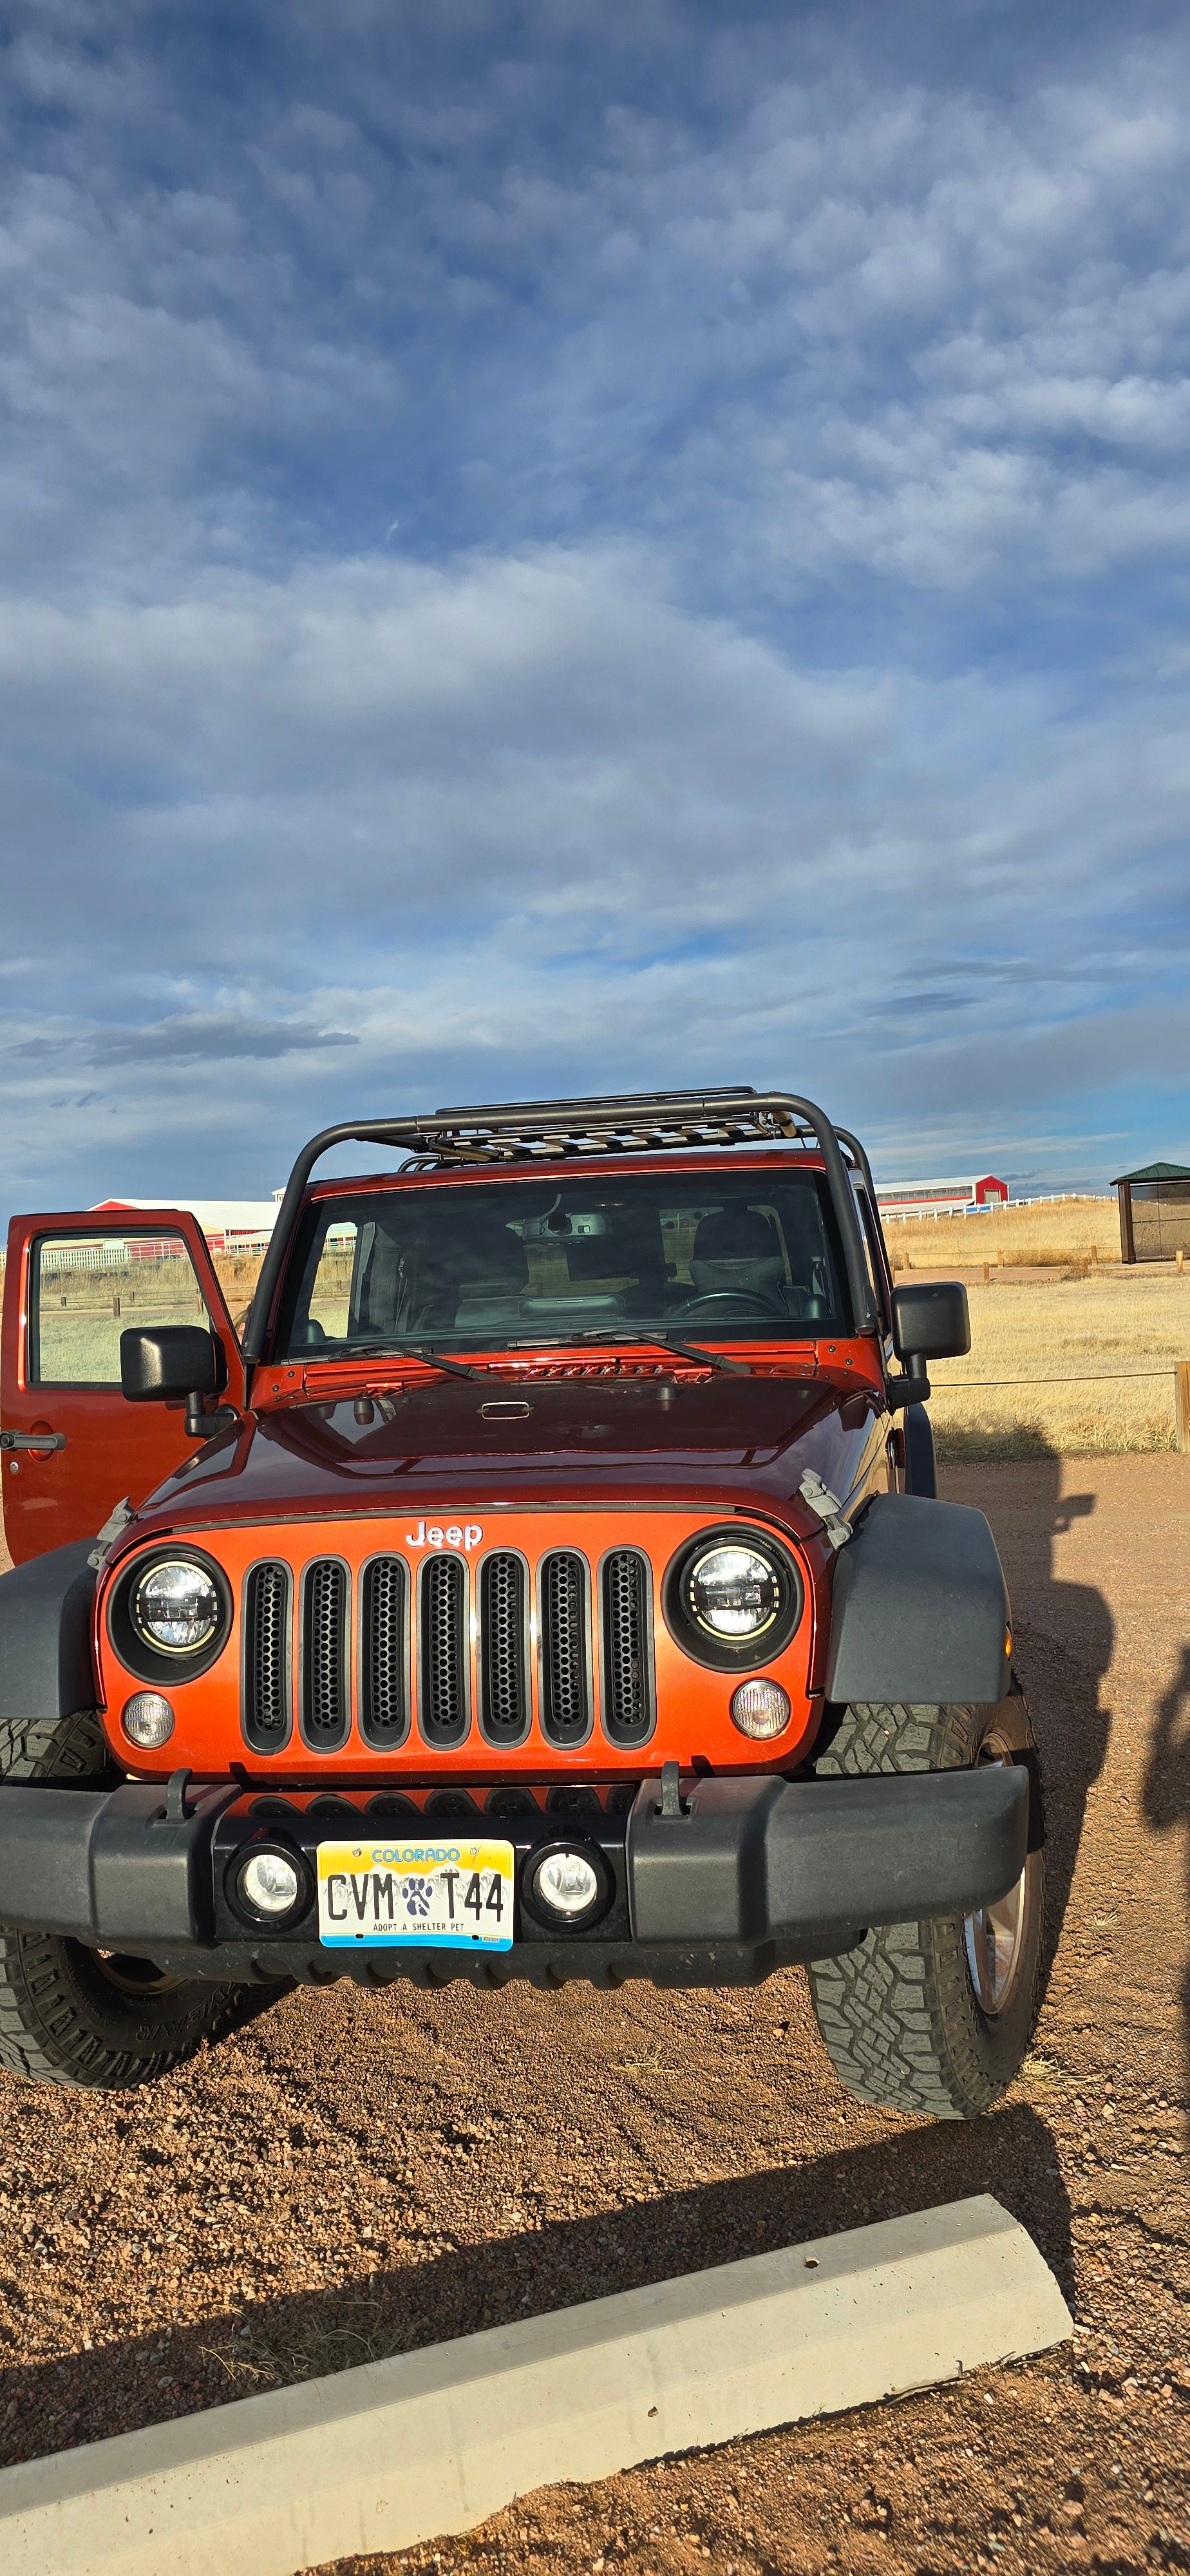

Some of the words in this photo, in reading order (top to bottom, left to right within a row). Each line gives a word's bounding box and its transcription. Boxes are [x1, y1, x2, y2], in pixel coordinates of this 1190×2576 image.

[406, 1520, 483, 1551] Jeep
[372, 1848, 460, 1863] COLORADO
[327, 1873, 394, 1920] CVM
[440, 1872, 504, 1922] T44
[412, 1922, 446, 1931] SHELTER
[451, 1923, 464, 1931] PET
